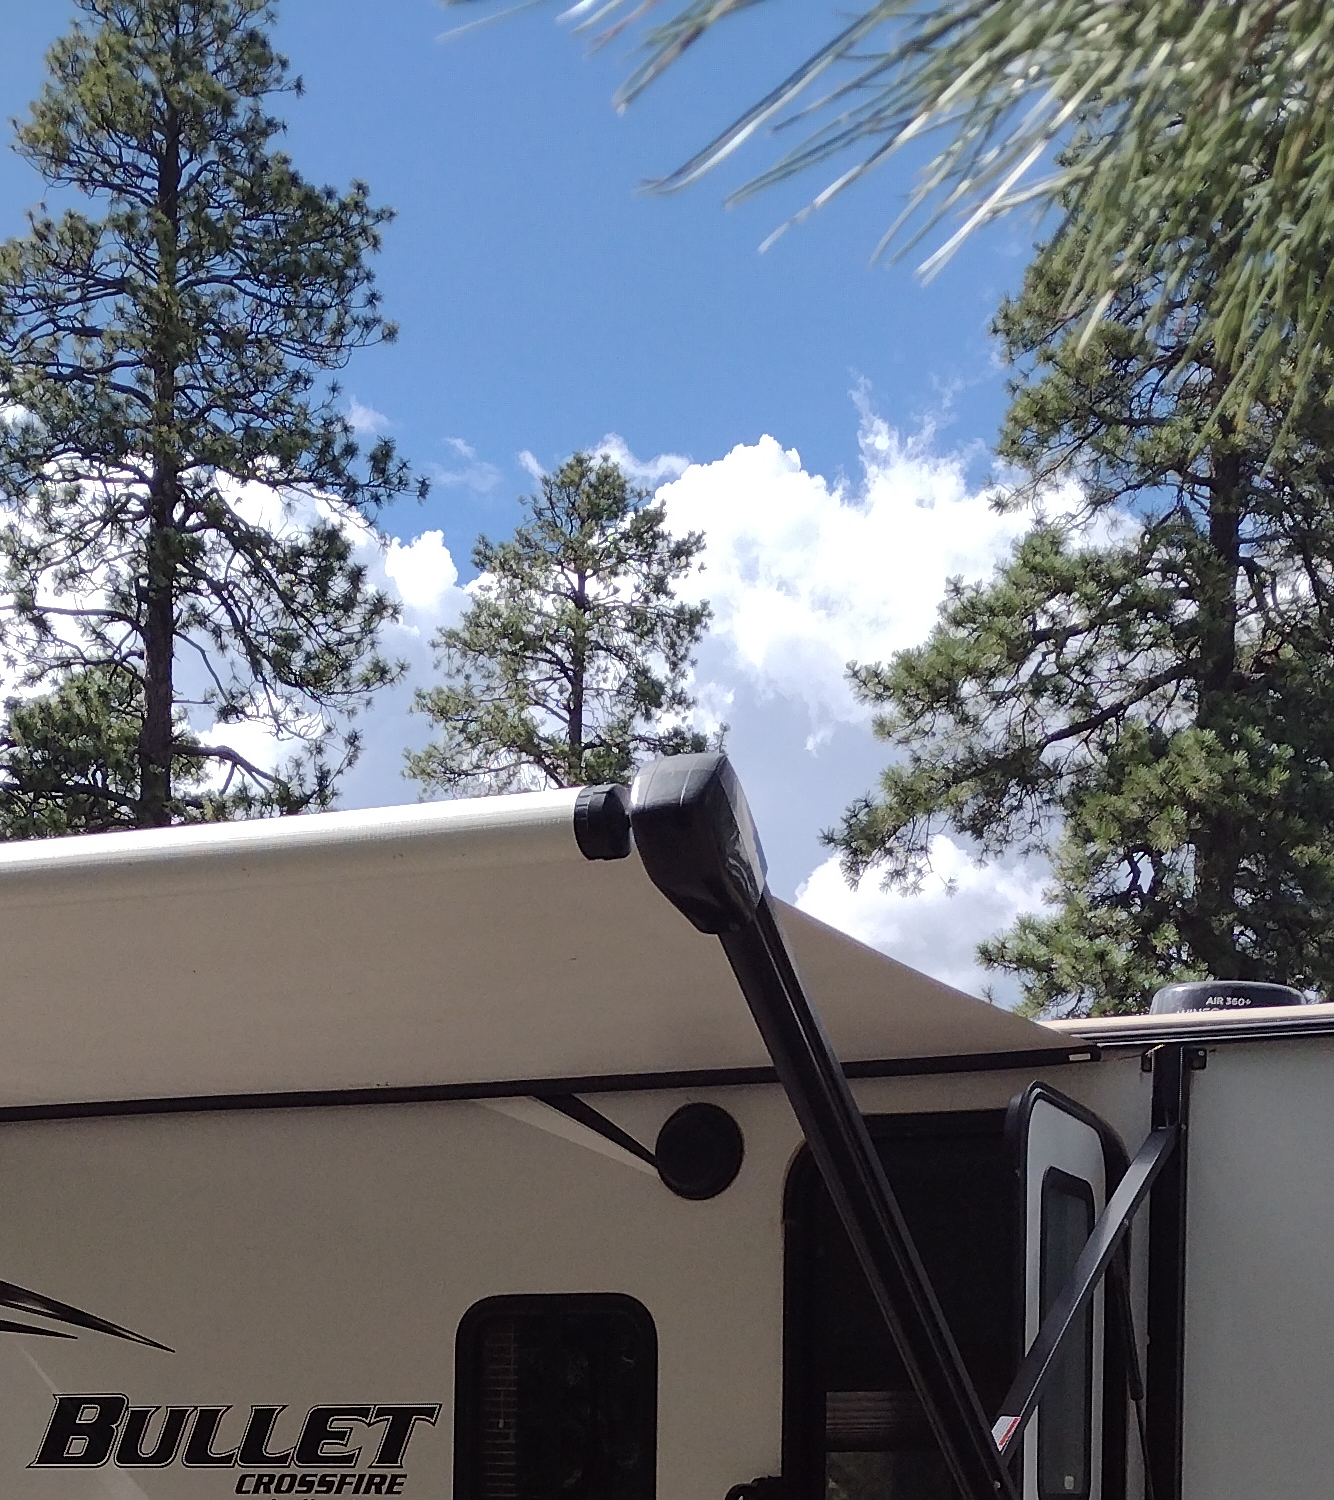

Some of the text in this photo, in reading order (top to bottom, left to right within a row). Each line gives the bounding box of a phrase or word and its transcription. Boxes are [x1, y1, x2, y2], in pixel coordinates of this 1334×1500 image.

[1205, 996, 1224, 1006] AIR
[26, 1392, 443, 1468] BULLET
[235, 1473, 408, 1495] CROSSFIRE
